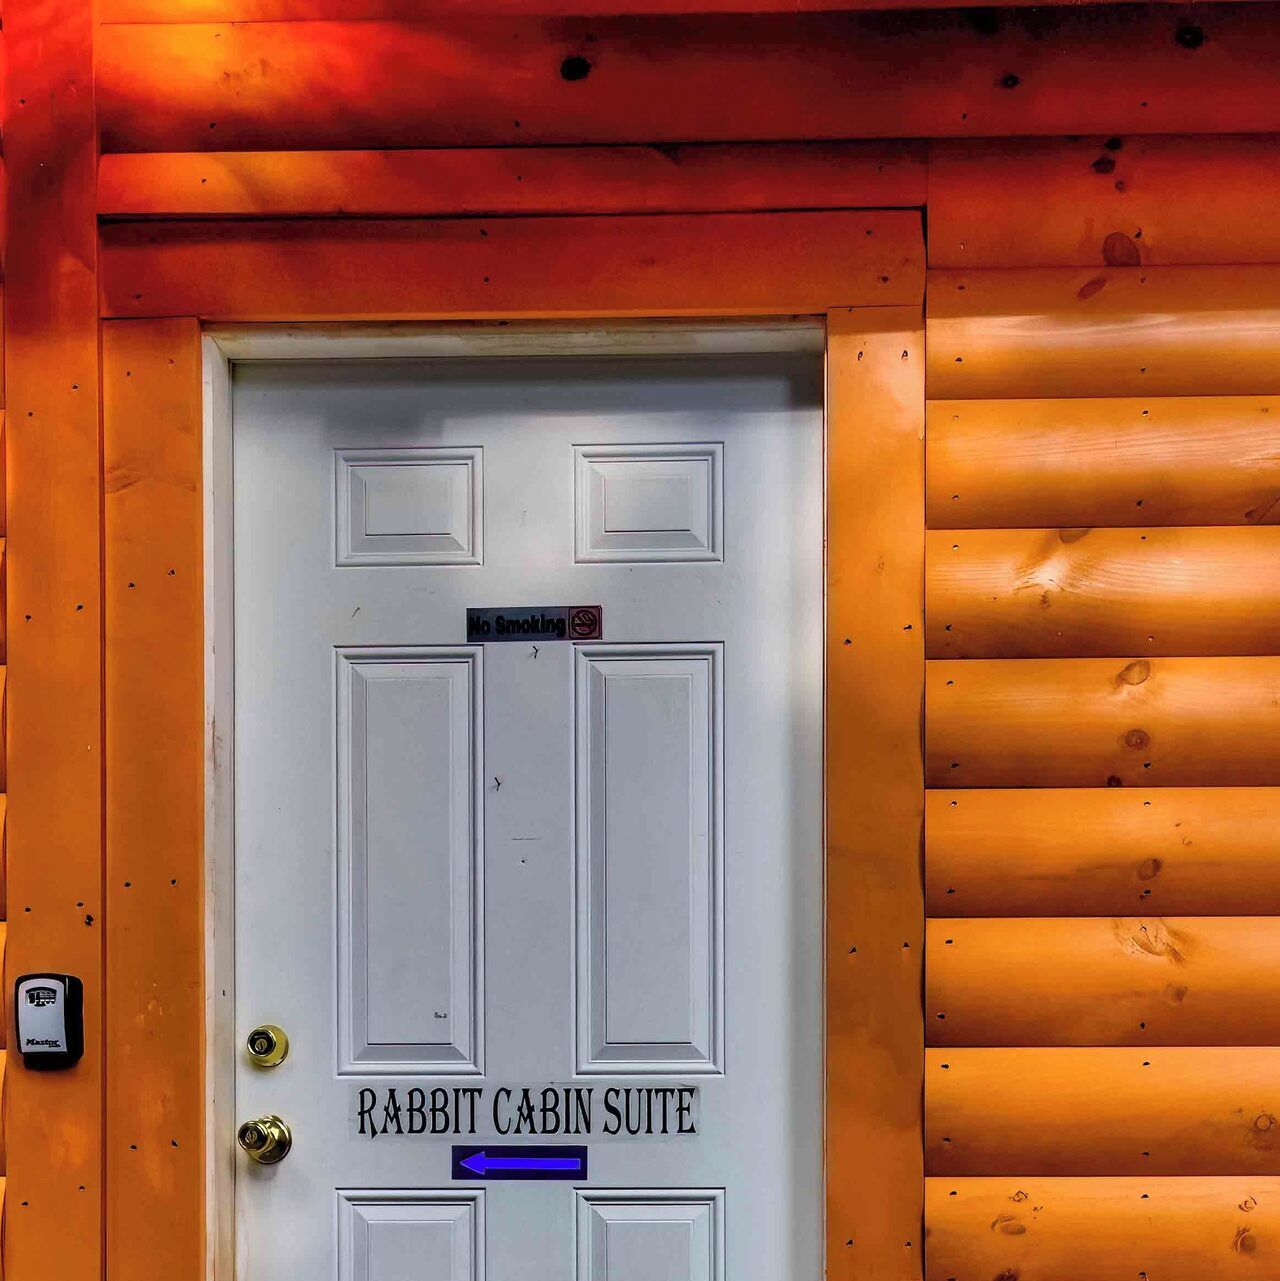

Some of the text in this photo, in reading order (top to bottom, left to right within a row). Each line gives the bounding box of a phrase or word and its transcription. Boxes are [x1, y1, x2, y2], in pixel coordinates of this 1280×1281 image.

[470, 614, 566, 638] No Smoking
[358, 1086, 697, 1139] RABBIT CABIN SUITE
